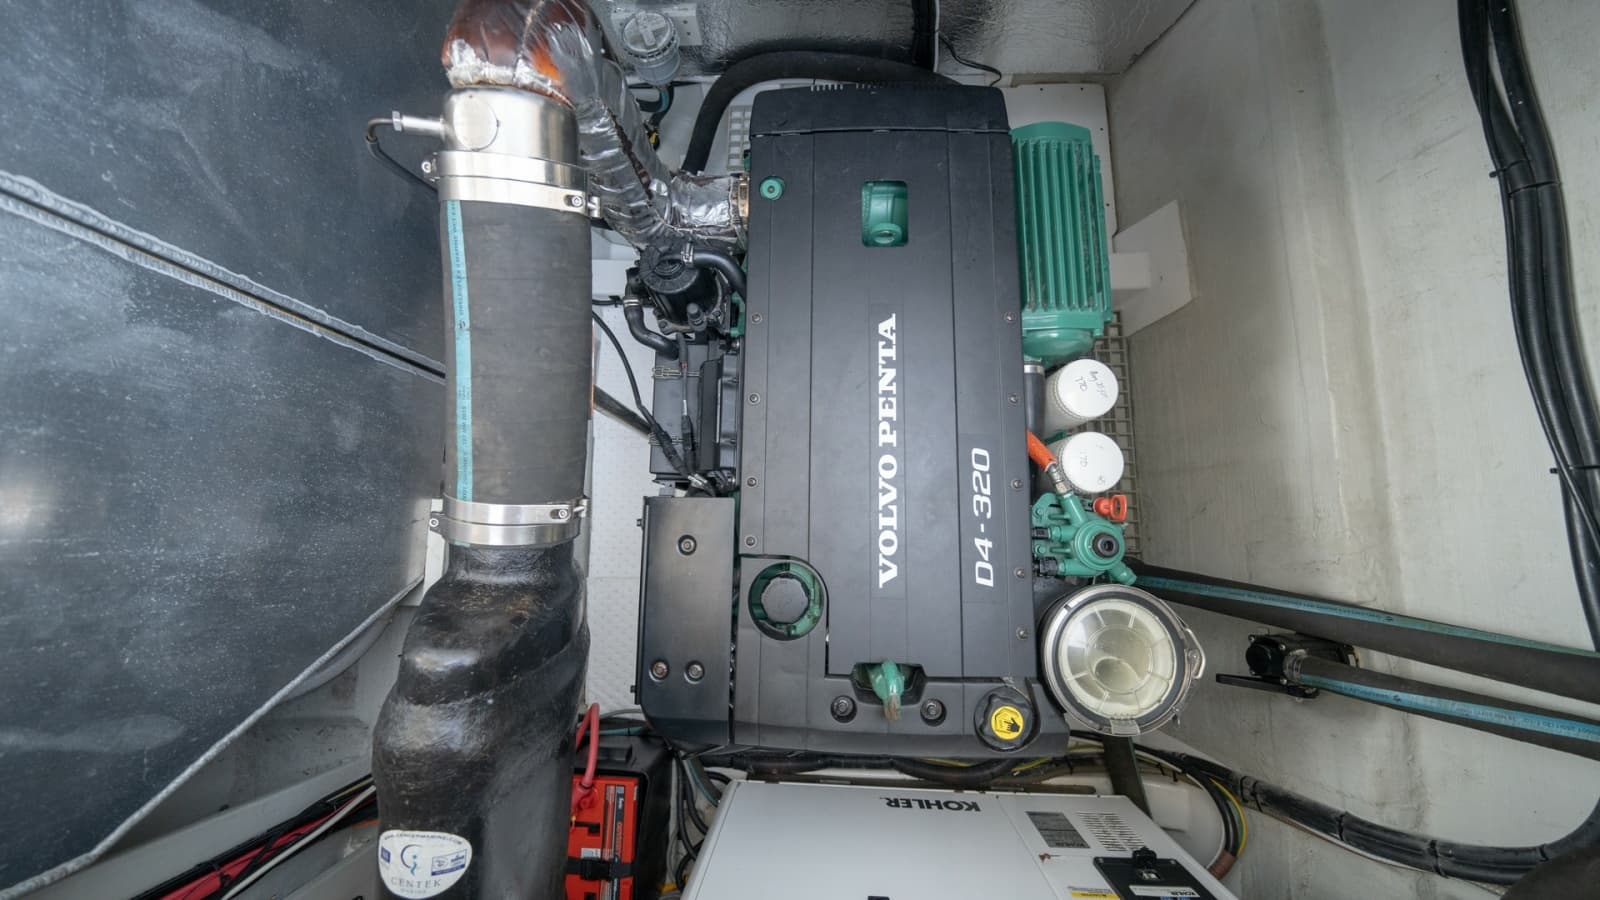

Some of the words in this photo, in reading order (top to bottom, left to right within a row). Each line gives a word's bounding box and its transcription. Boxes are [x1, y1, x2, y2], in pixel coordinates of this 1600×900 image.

[878, 313, 897, 447] PENTA
[878, 454, 898, 588] VOLVO
[884, 797, 981, 812] KOHLER
[390, 877, 442, 888] CENTEK
